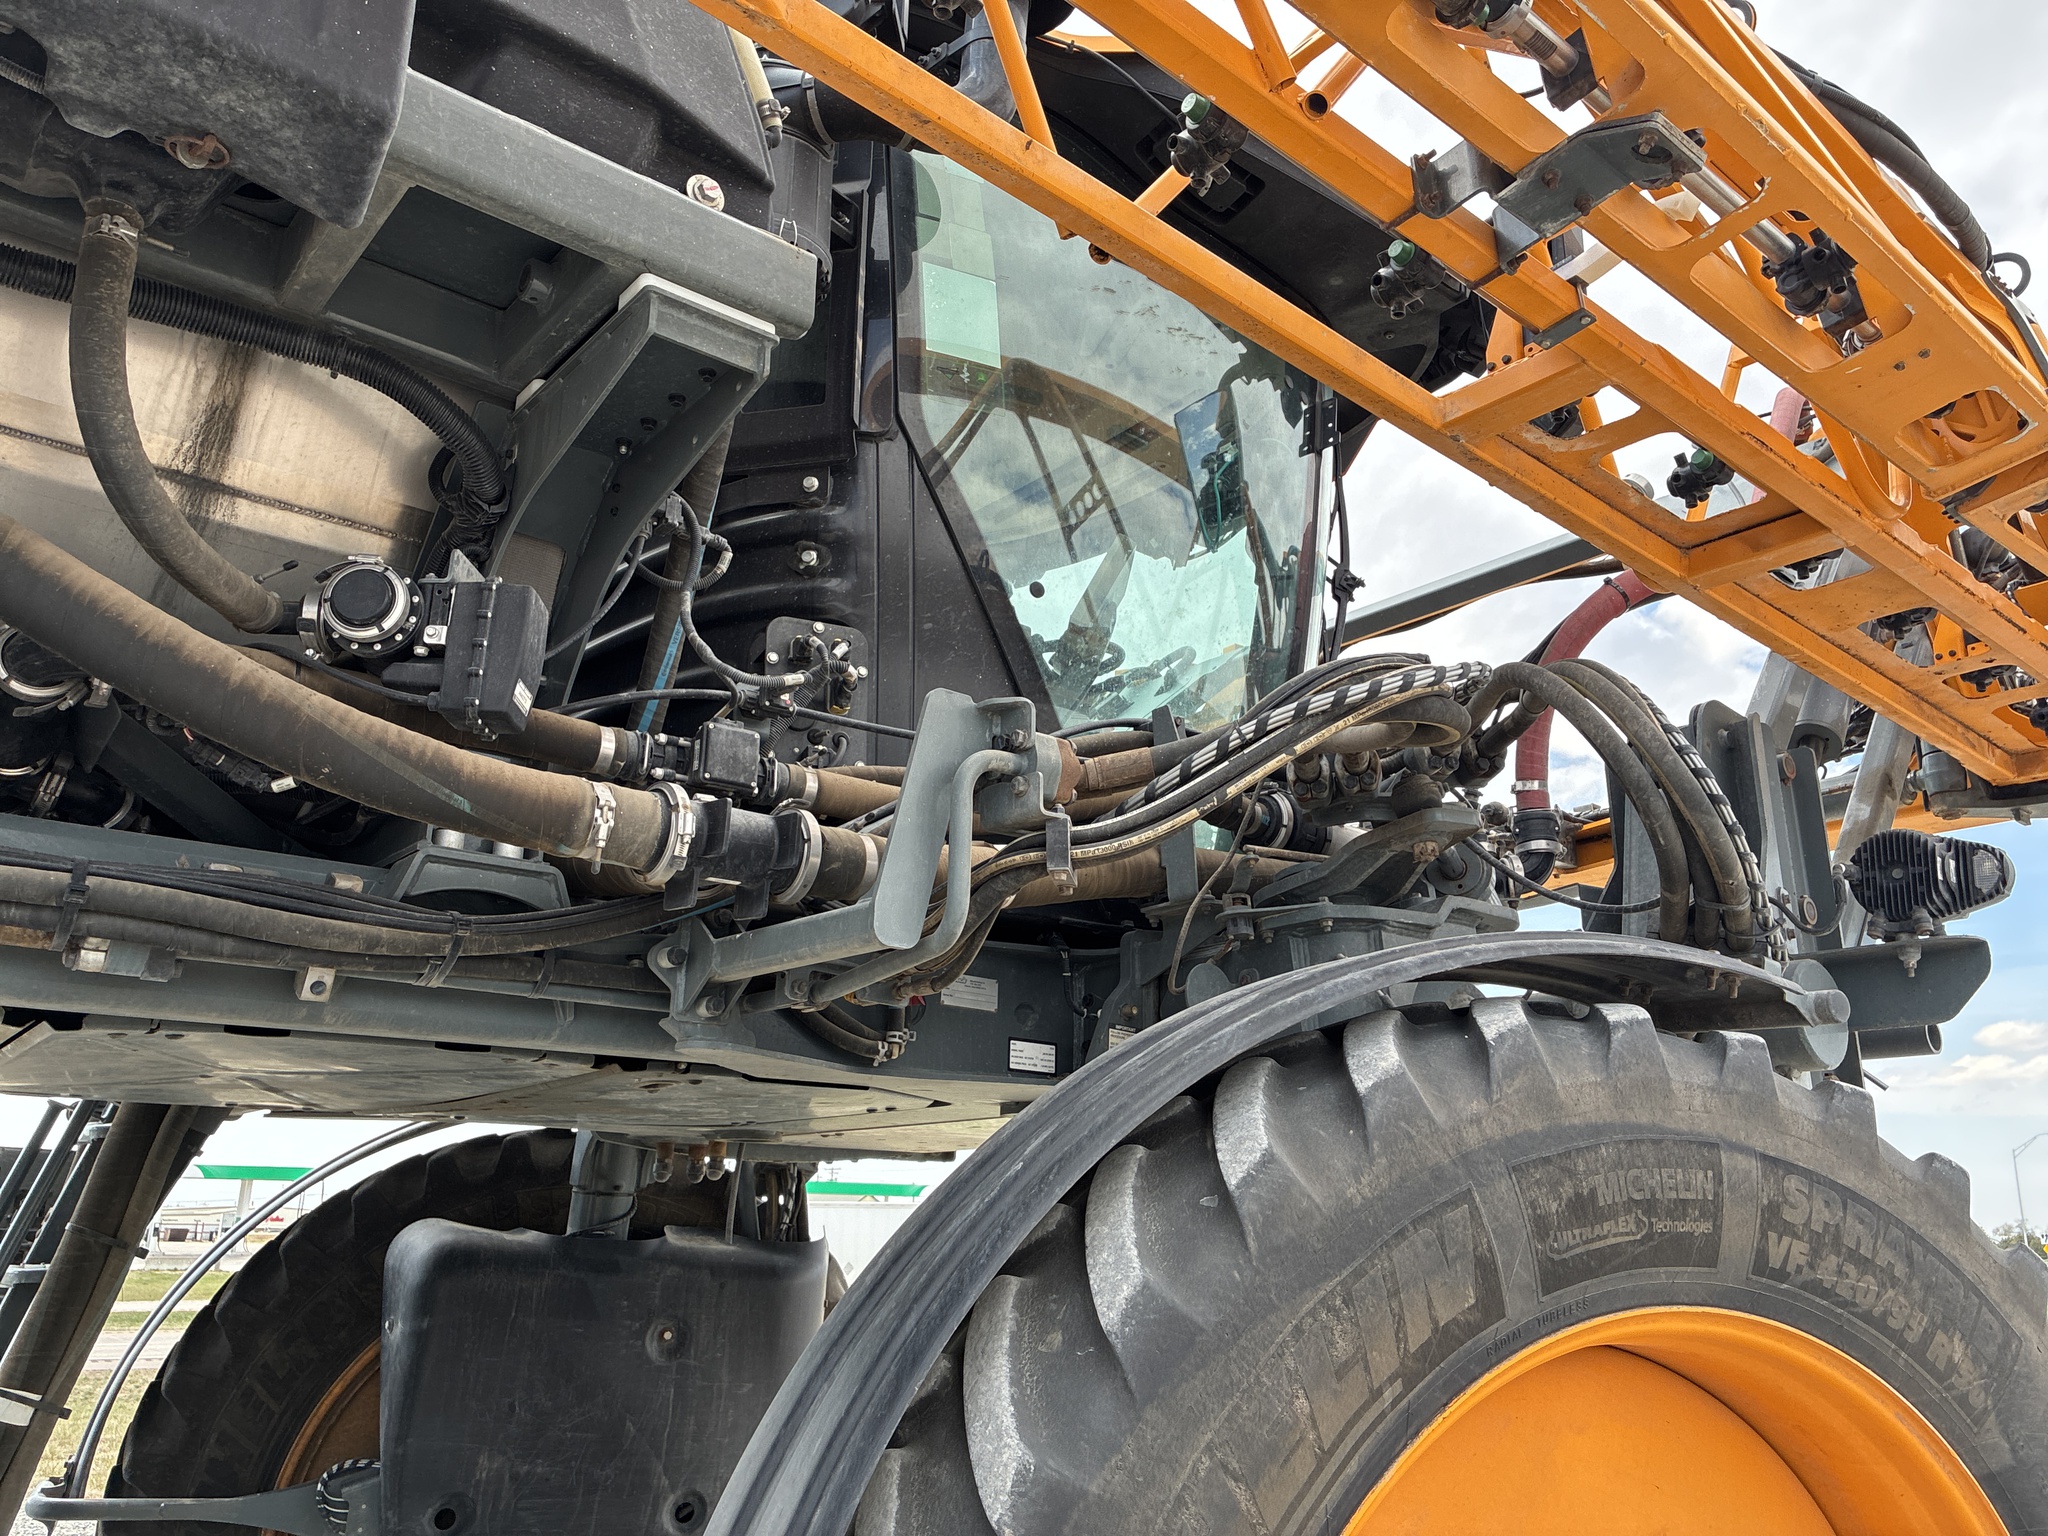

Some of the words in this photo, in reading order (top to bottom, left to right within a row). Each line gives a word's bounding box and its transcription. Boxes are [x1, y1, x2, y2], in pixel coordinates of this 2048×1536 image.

[1594, 1168, 1714, 1207] MICHELIN
[1553, 1213, 1637, 1251] ULTRAFLEX
[1651, 1217, 1714, 1237] Technologies
[1767, 1230, 1811, 1277] VF
[1485, 1328, 1523, 1358] RADIAL
[1536, 1297, 1590, 1328] TUBELESS
